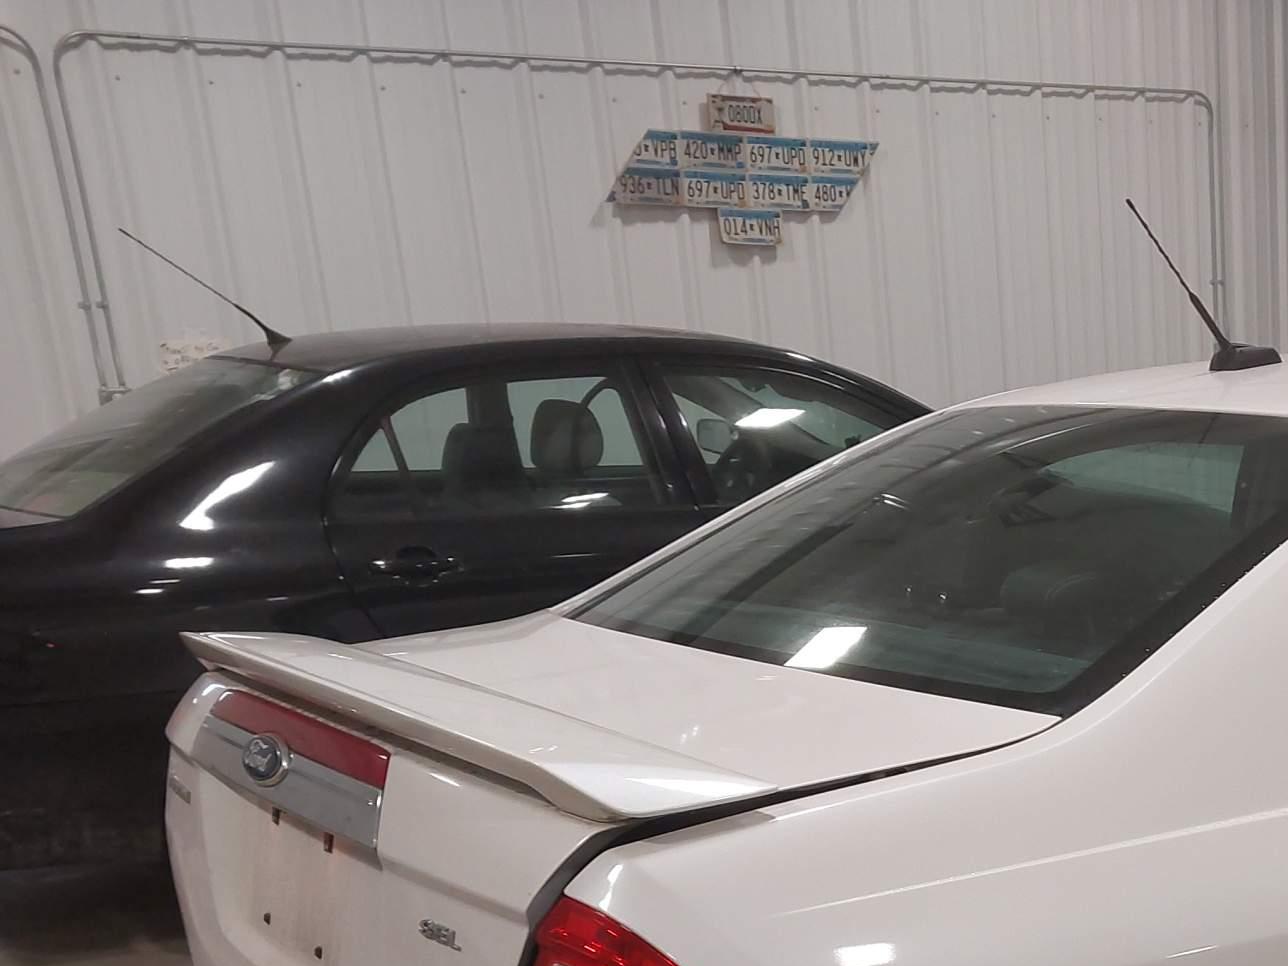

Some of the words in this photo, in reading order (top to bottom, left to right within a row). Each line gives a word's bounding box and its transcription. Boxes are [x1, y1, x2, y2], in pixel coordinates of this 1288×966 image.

[750, 146, 773, 164] 697
[812, 147, 836, 166] 912
[687, 180, 711, 198] 697
